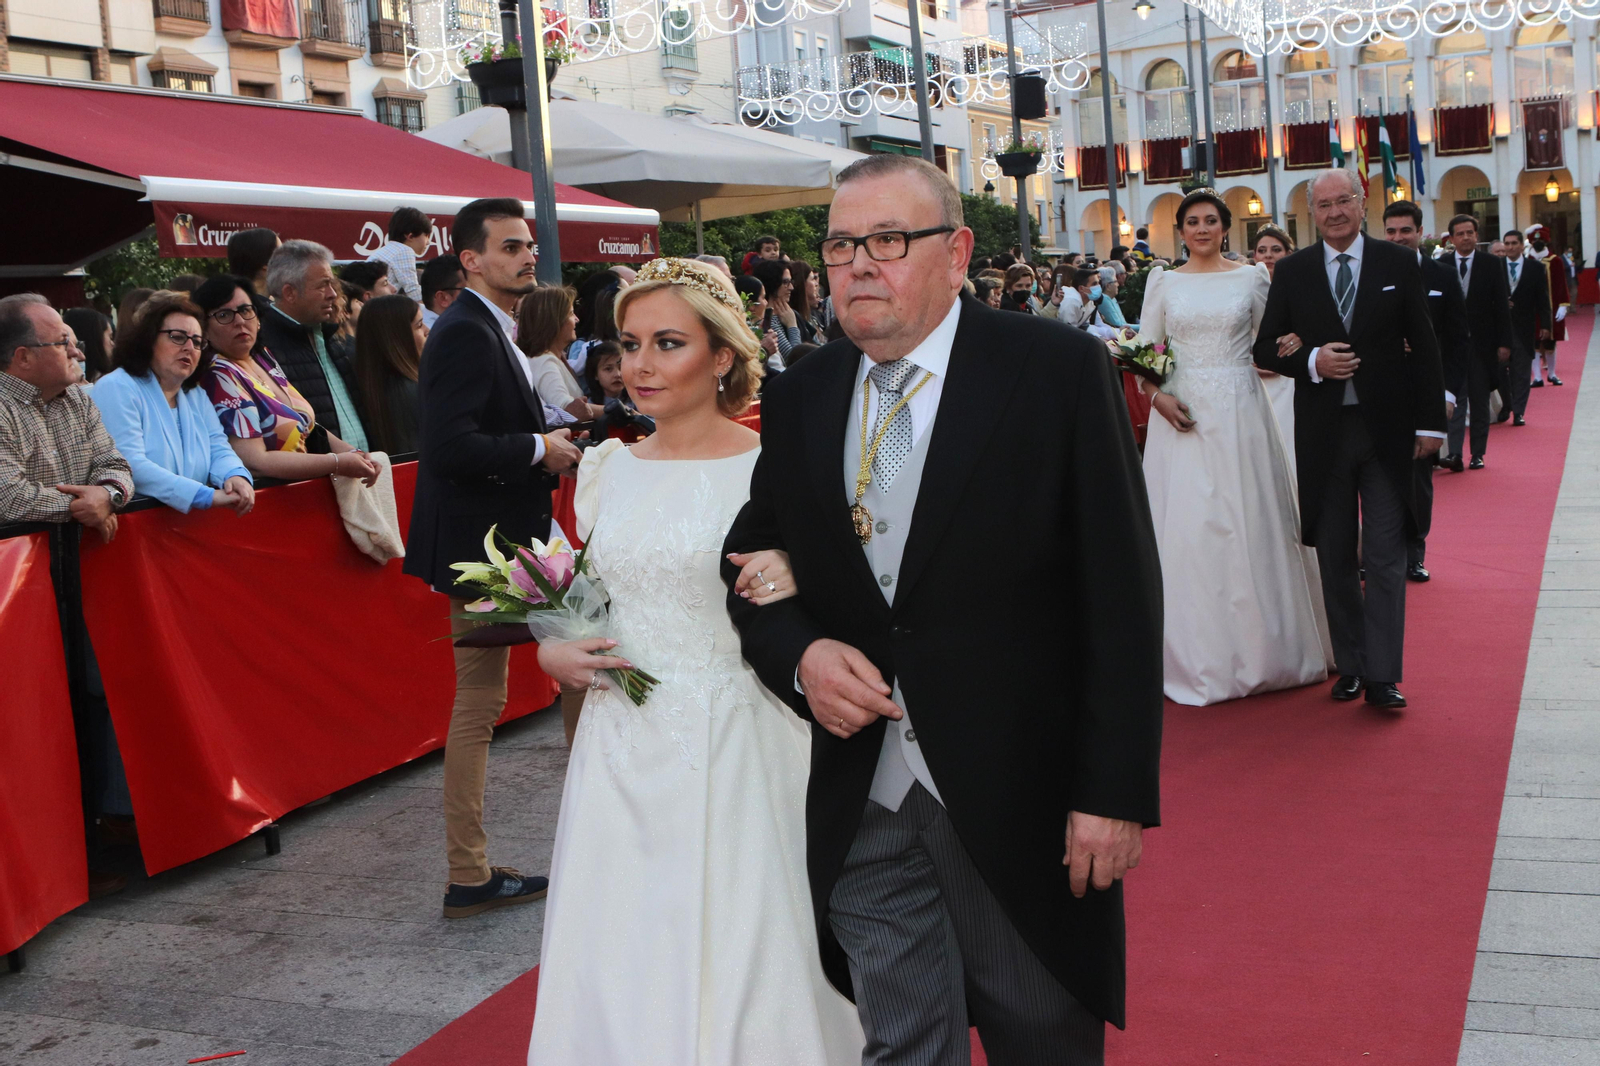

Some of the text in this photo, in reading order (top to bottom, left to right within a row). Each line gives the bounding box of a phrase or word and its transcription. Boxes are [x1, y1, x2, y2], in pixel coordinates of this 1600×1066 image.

[1467, 187, 1497, 199] ENTRA
[198, 224, 239, 246] Cruz
[598, 238, 640, 257] Cruzcampo
